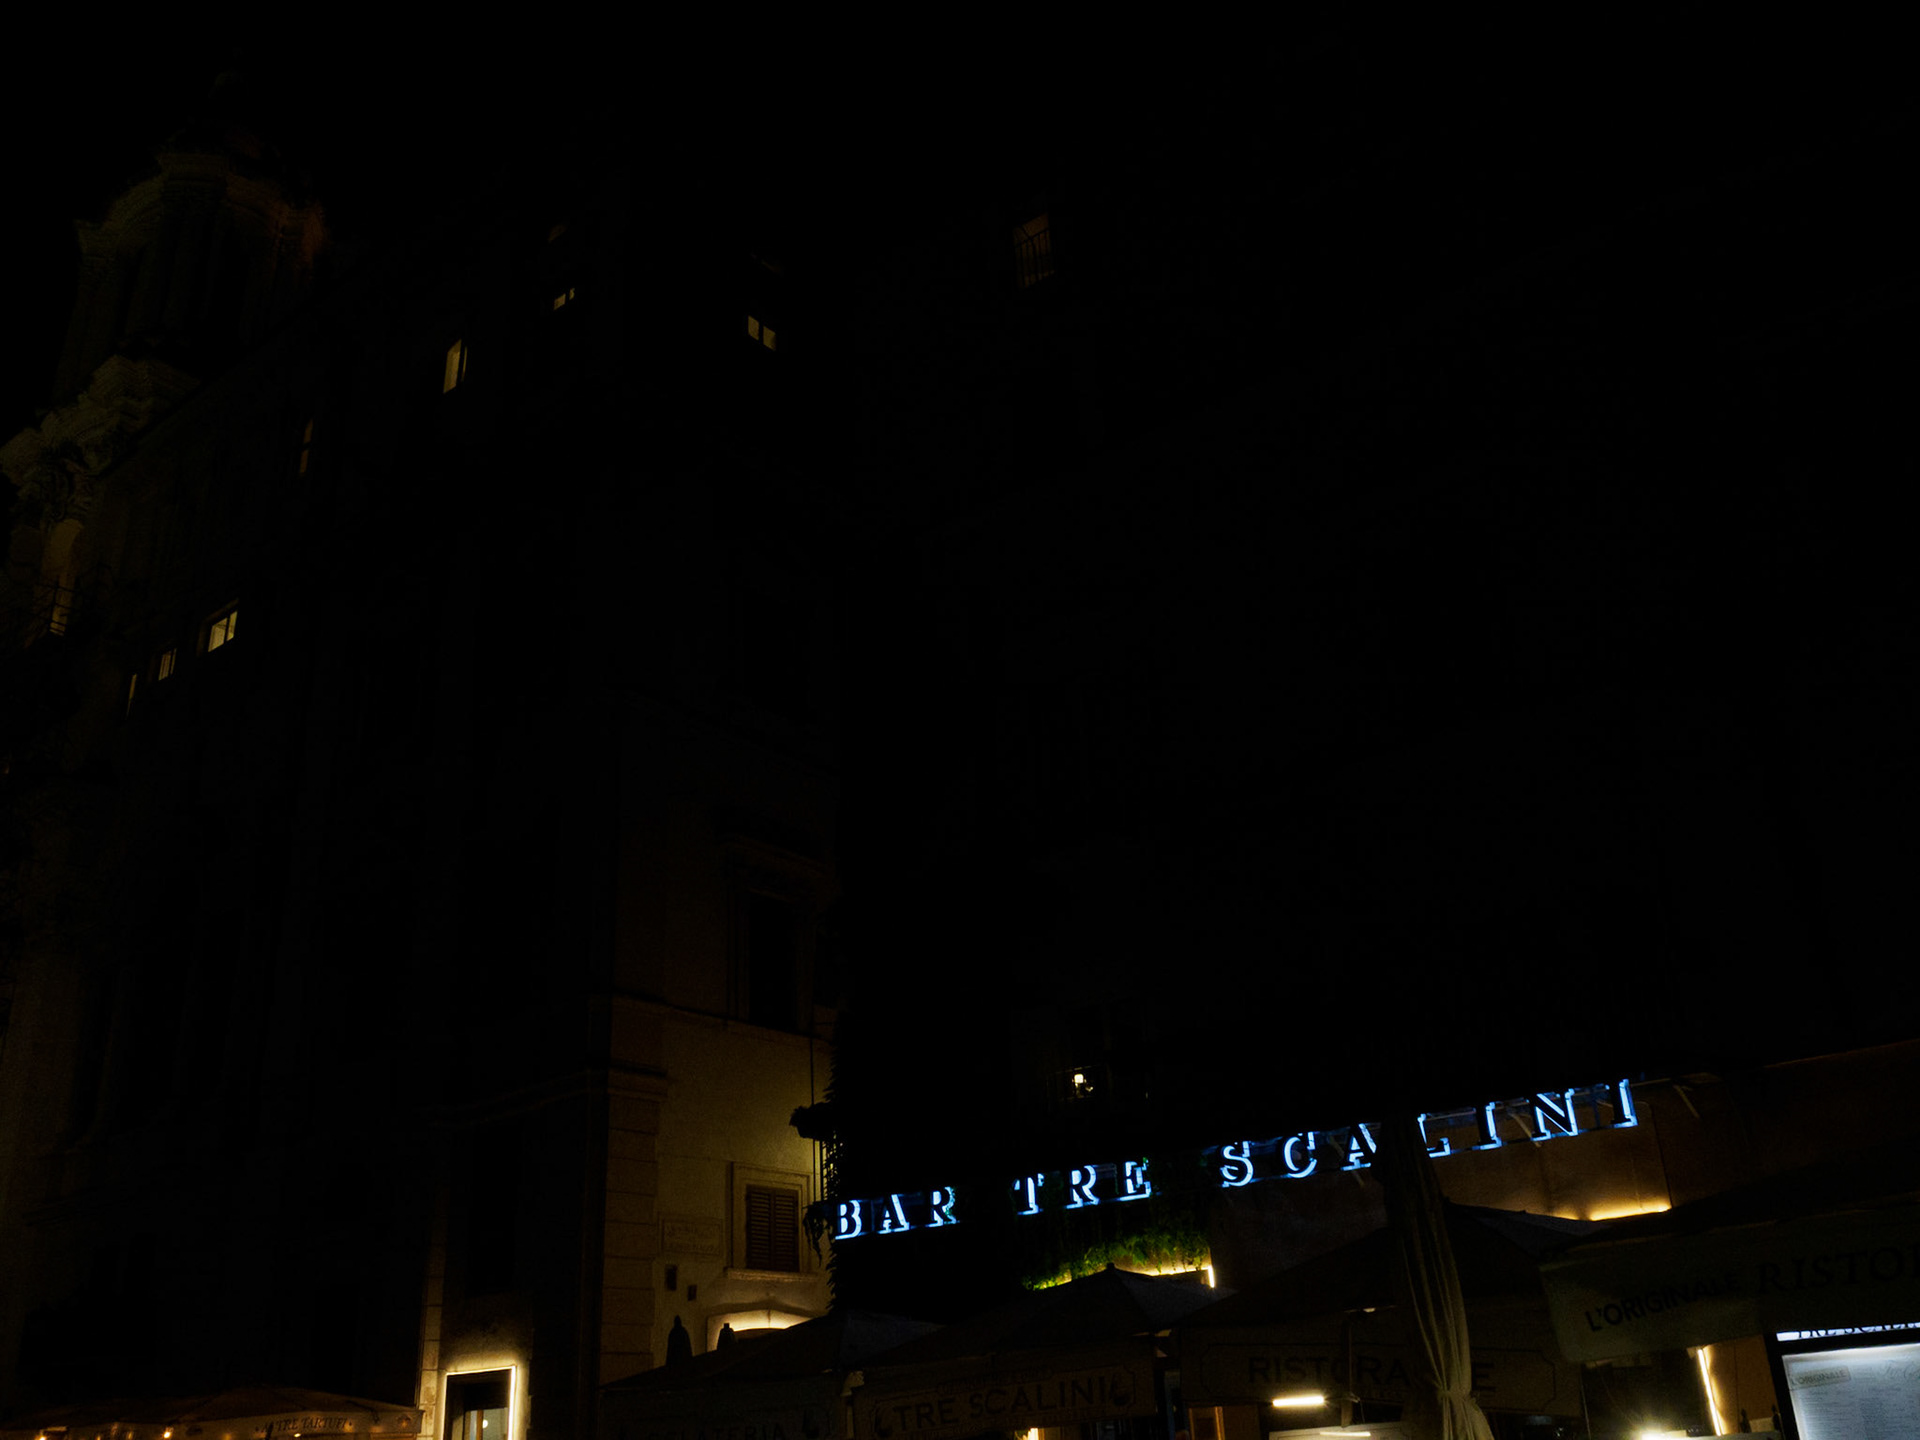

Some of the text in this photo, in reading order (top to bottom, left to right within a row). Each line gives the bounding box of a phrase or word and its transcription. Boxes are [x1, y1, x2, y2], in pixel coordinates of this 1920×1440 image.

[835, 1077, 1640, 1241] BAR TRE SCALINI
[1585, 1272, 1742, 1333] L'ORIGINALE
[1248, 1355, 1497, 1393] RISTORAE
[278, 1418, 299, 1431] TRE
[892, 1397, 959, 1431] TRE
[969, 1376, 1106, 1419] SCALINI
